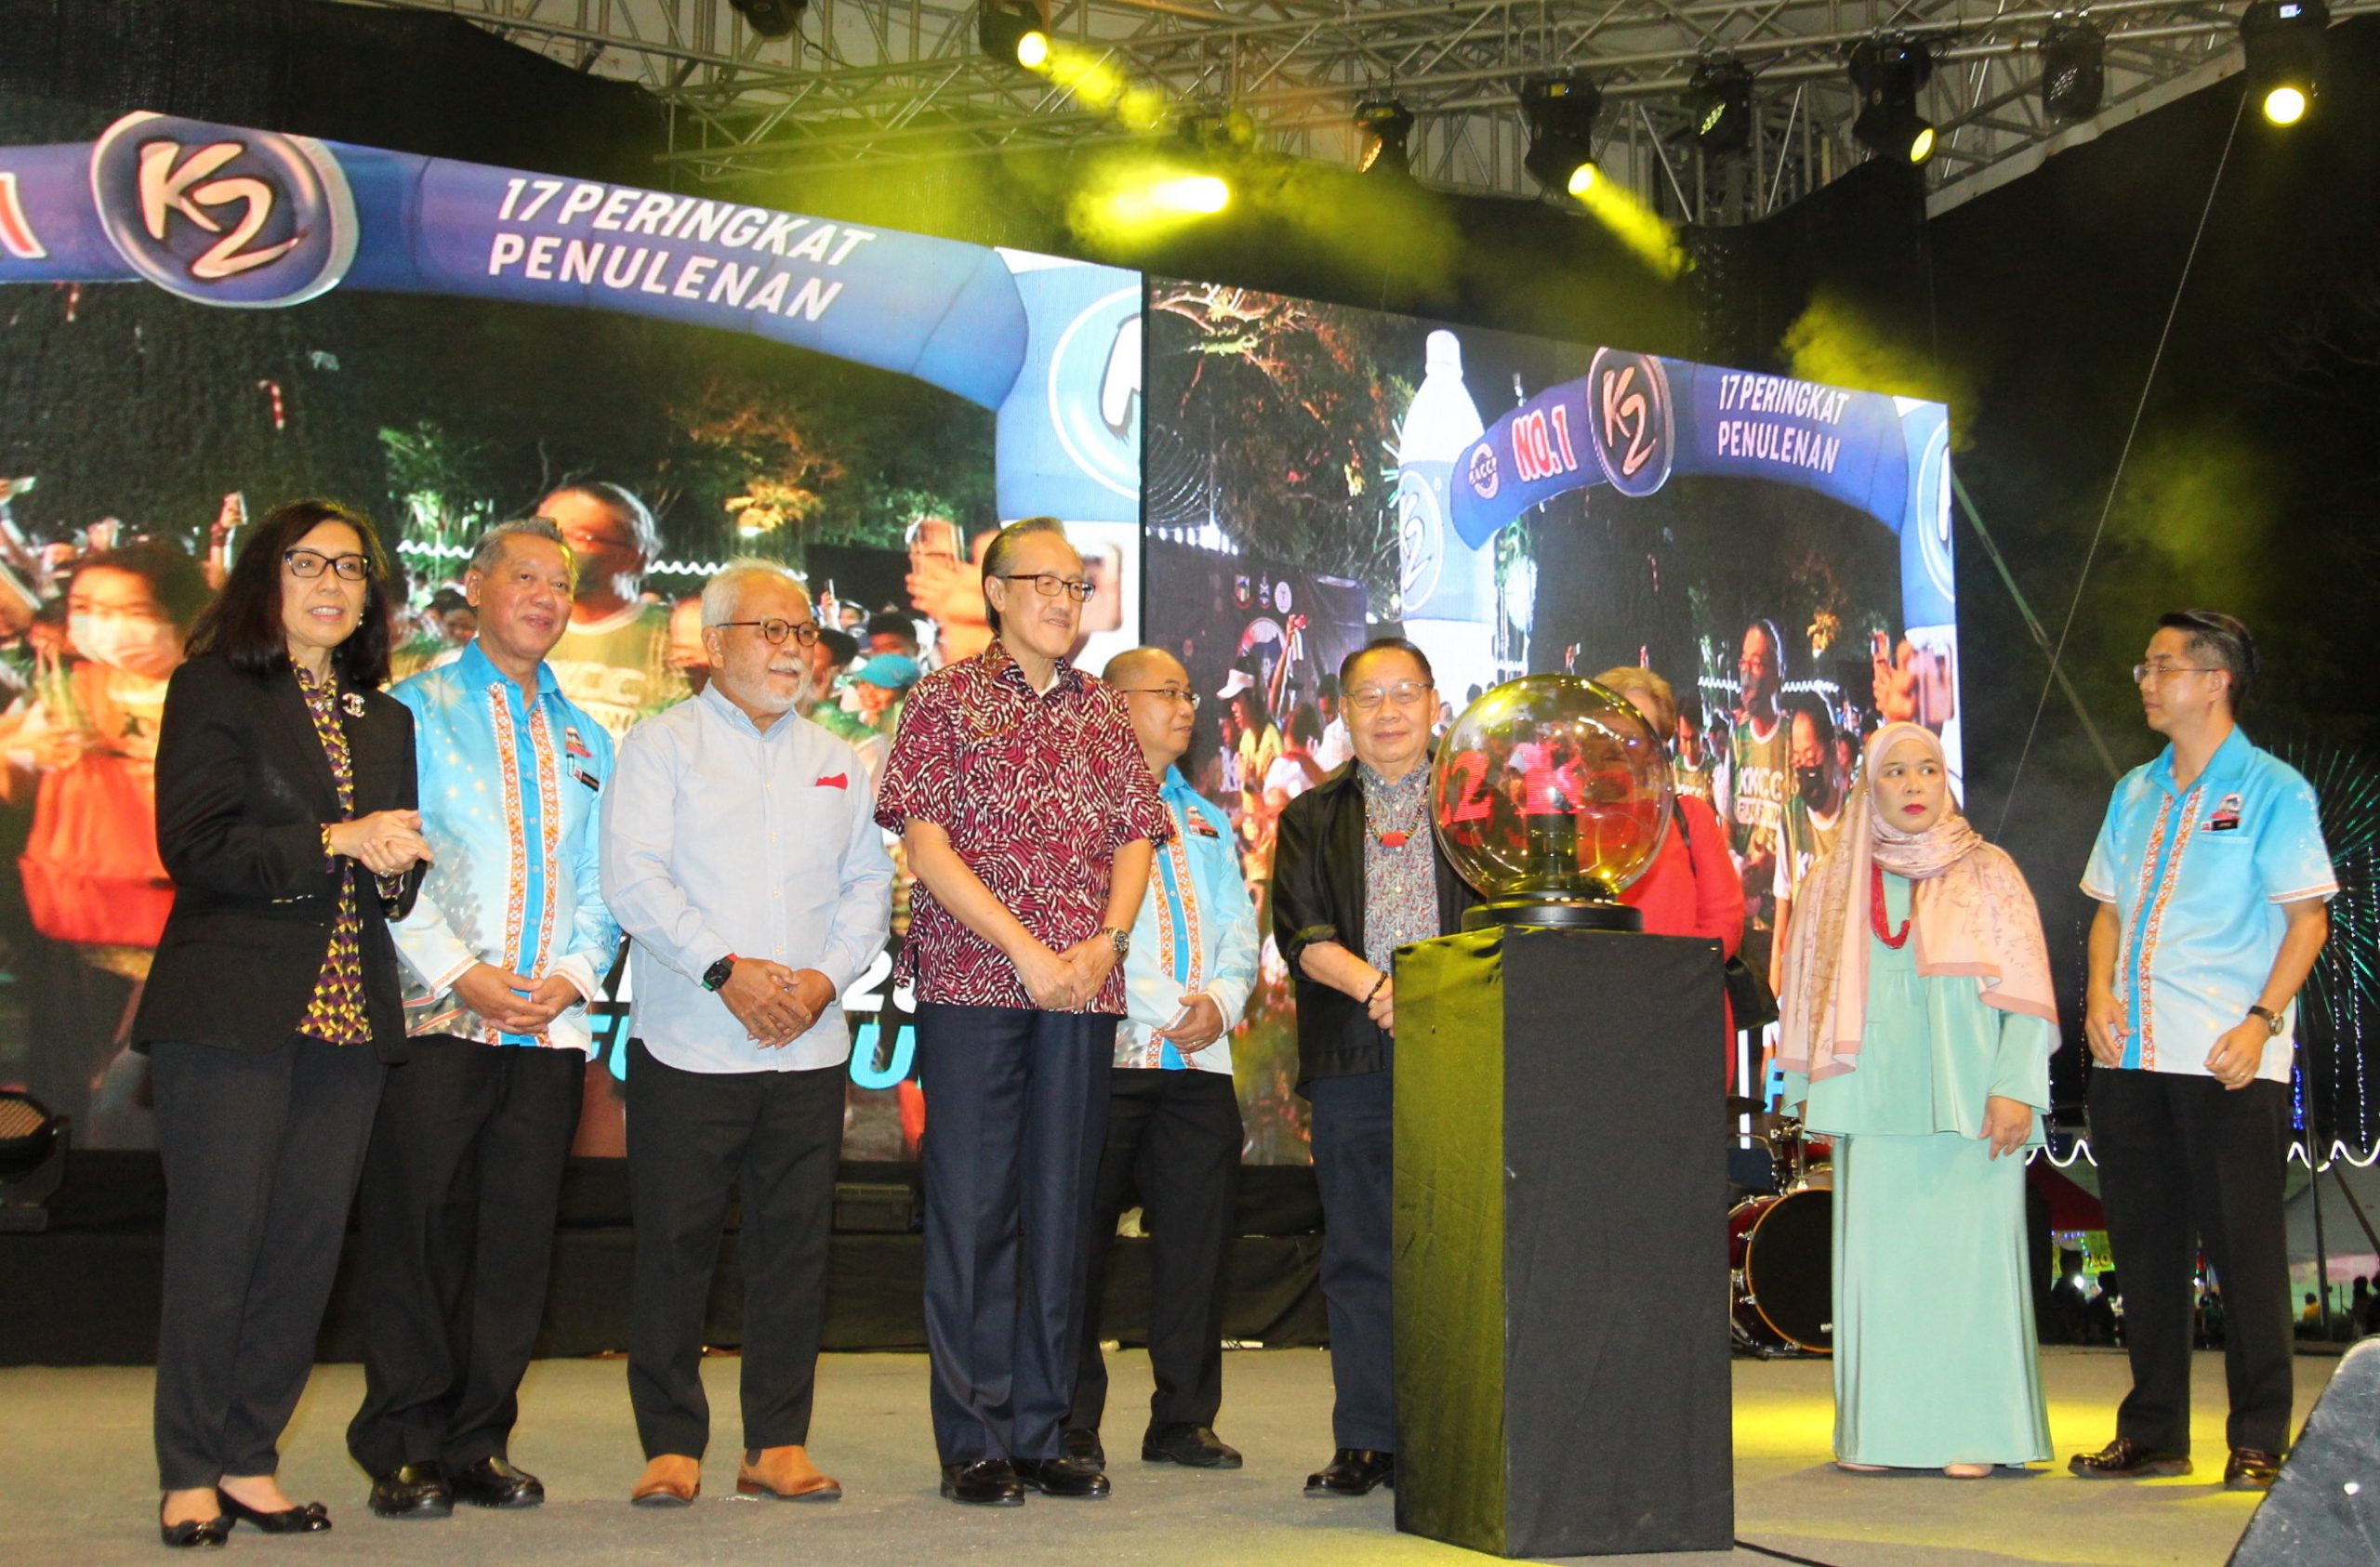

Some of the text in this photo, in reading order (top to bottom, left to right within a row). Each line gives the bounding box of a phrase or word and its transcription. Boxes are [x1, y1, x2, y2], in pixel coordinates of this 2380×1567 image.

[139, 140, 299, 279] K2
[497, 178, 877, 267] 17 PERINGKAT
[488, 232, 843, 323] PENULENAN
[1512, 406, 1578, 482] NO.1
[1603, 366, 1658, 476] K2
[1719, 374, 1850, 426] 17 PERINGKAT
[1718, 421, 1841, 474] PENULENAN
